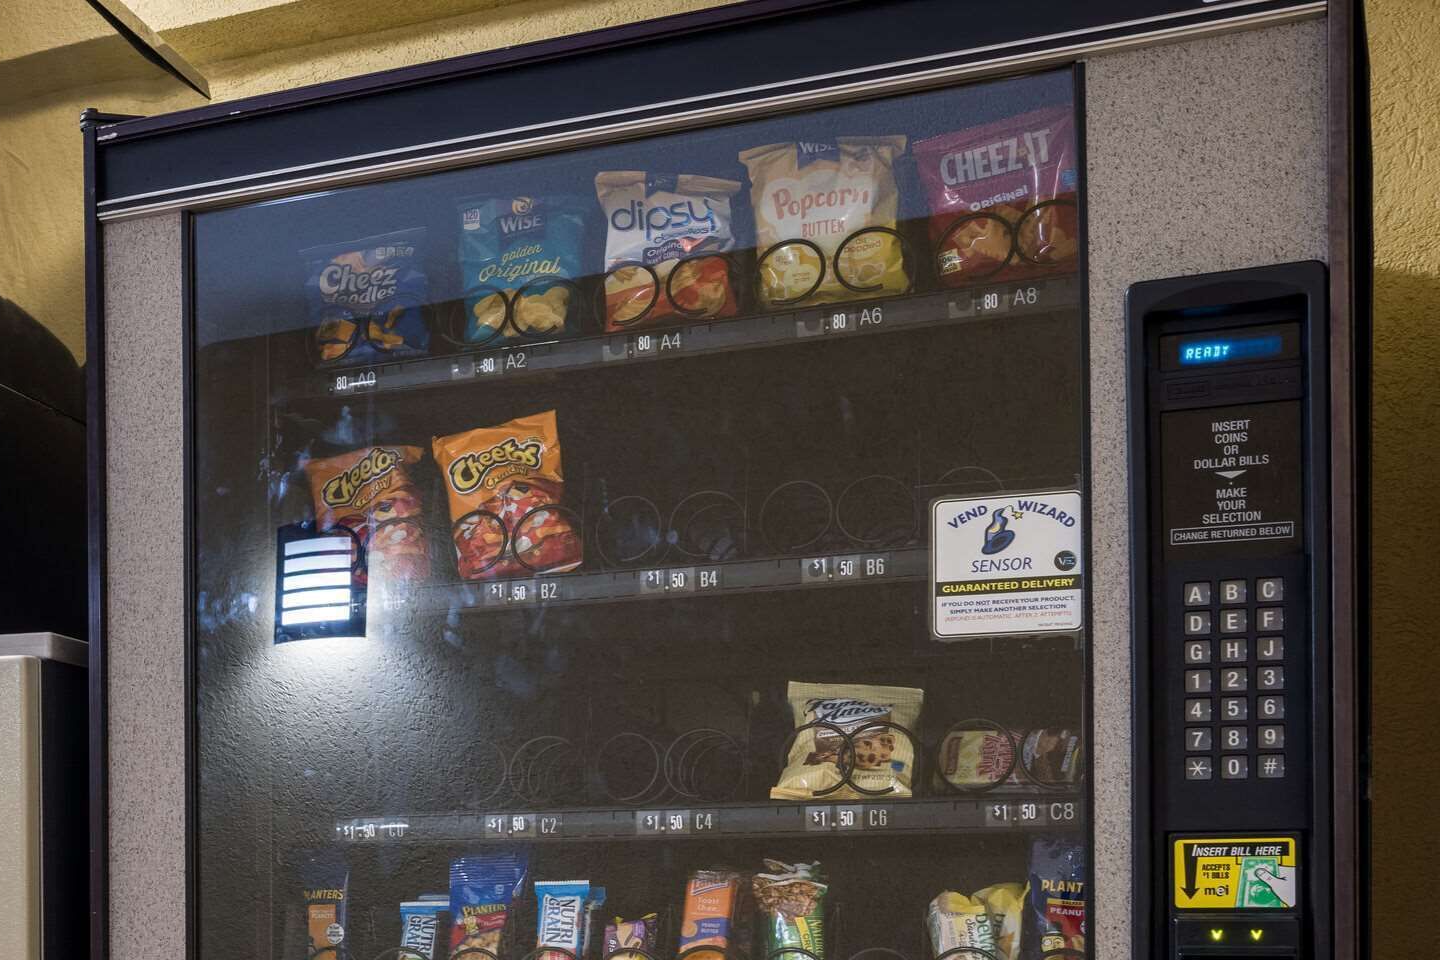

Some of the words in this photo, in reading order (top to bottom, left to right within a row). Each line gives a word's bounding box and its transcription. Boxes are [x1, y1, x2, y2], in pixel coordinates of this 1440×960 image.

[500, 214, 544, 234] WISE
[611, 198, 717, 242] dipsy
[478, 256, 562, 283] Original
[320, 264, 400, 294] Cheez
[1014, 287, 1037, 306] A8
[860, 307, 882, 326] A6
[661, 333, 681, 350] A4
[507, 352, 527, 369] A2
[1186, 345, 1230, 360] READY
[1212, 420, 1250, 432] INSERT
[1215, 432, 1248, 444] COINS
[1224, 445, 1239, 455] OR
[451, 438, 541, 490] Cheetos
[1194, 457, 1236, 469] DOLLAR
[1239, 454, 1270, 466] BILLS
[1216, 488, 1247, 499] MAKE
[1217, 500, 1246, 511] YOUR
[948, 505, 988, 529] VEND
[1017, 500, 1076, 528] WIZARD
[1202, 511, 1262, 524] SELECTION
[1174, 531, 1209, 541] CHANGE
[1211, 528, 1257, 539] RETURNED
[1260, 526, 1291, 536] BELOW
[866, 559, 885, 576] B6
[971, 557, 1033, 573] SENSOR
[700, 571, 718, 587] B4
[942, 581, 1019, 593] GUARANTEED
[1021, 578, 1075, 588] DELIVERY
[541, 583, 557, 599] B2
[1189, 587, 1202, 603] A
[1226, 584, 1238, 600] B
[1263, 582, 1275, 598] C
[1190, 616, 1202, 632] D
[1227, 614, 1238, 629] E
[1264, 611, 1274, 627] F
[1190, 644, 1203, 660] G
[1227, 643, 1238, 658] H
[1264, 640, 1274, 656] J
[1192, 674, 1200, 689] 1
[1228, 672, 1239, 687] 2
[1264, 670, 1275, 685] 3
[1191, 702, 1202, 718] 4
[1228, 701, 1239, 716] 5
[1264, 699, 1276, 715] 6
[1192, 732, 1203, 747] 7
[1228, 730, 1240, 746] 8
[1264, 729, 1276, 744] 9
[1228, 760, 1239, 775] 0
[1264, 758, 1277, 774] #
[869, 809, 887, 826] C6
[1050, 803, 1074, 820] C8
[541, 816, 557, 833] C2
[696, 814, 712, 829] C4
[1192, 844, 1227, 857] INSERT
[1231, 847, 1252, 856] BILL
[1255, 846, 1282, 856] HERE
[1212, 871, 1229, 879] BILLS
[1042, 880, 1084, 893] PLANT
[1204, 885, 1229, 896] mei
[545, 896, 561, 945] GRAIN
[560, 897, 577, 945] NUTRI
